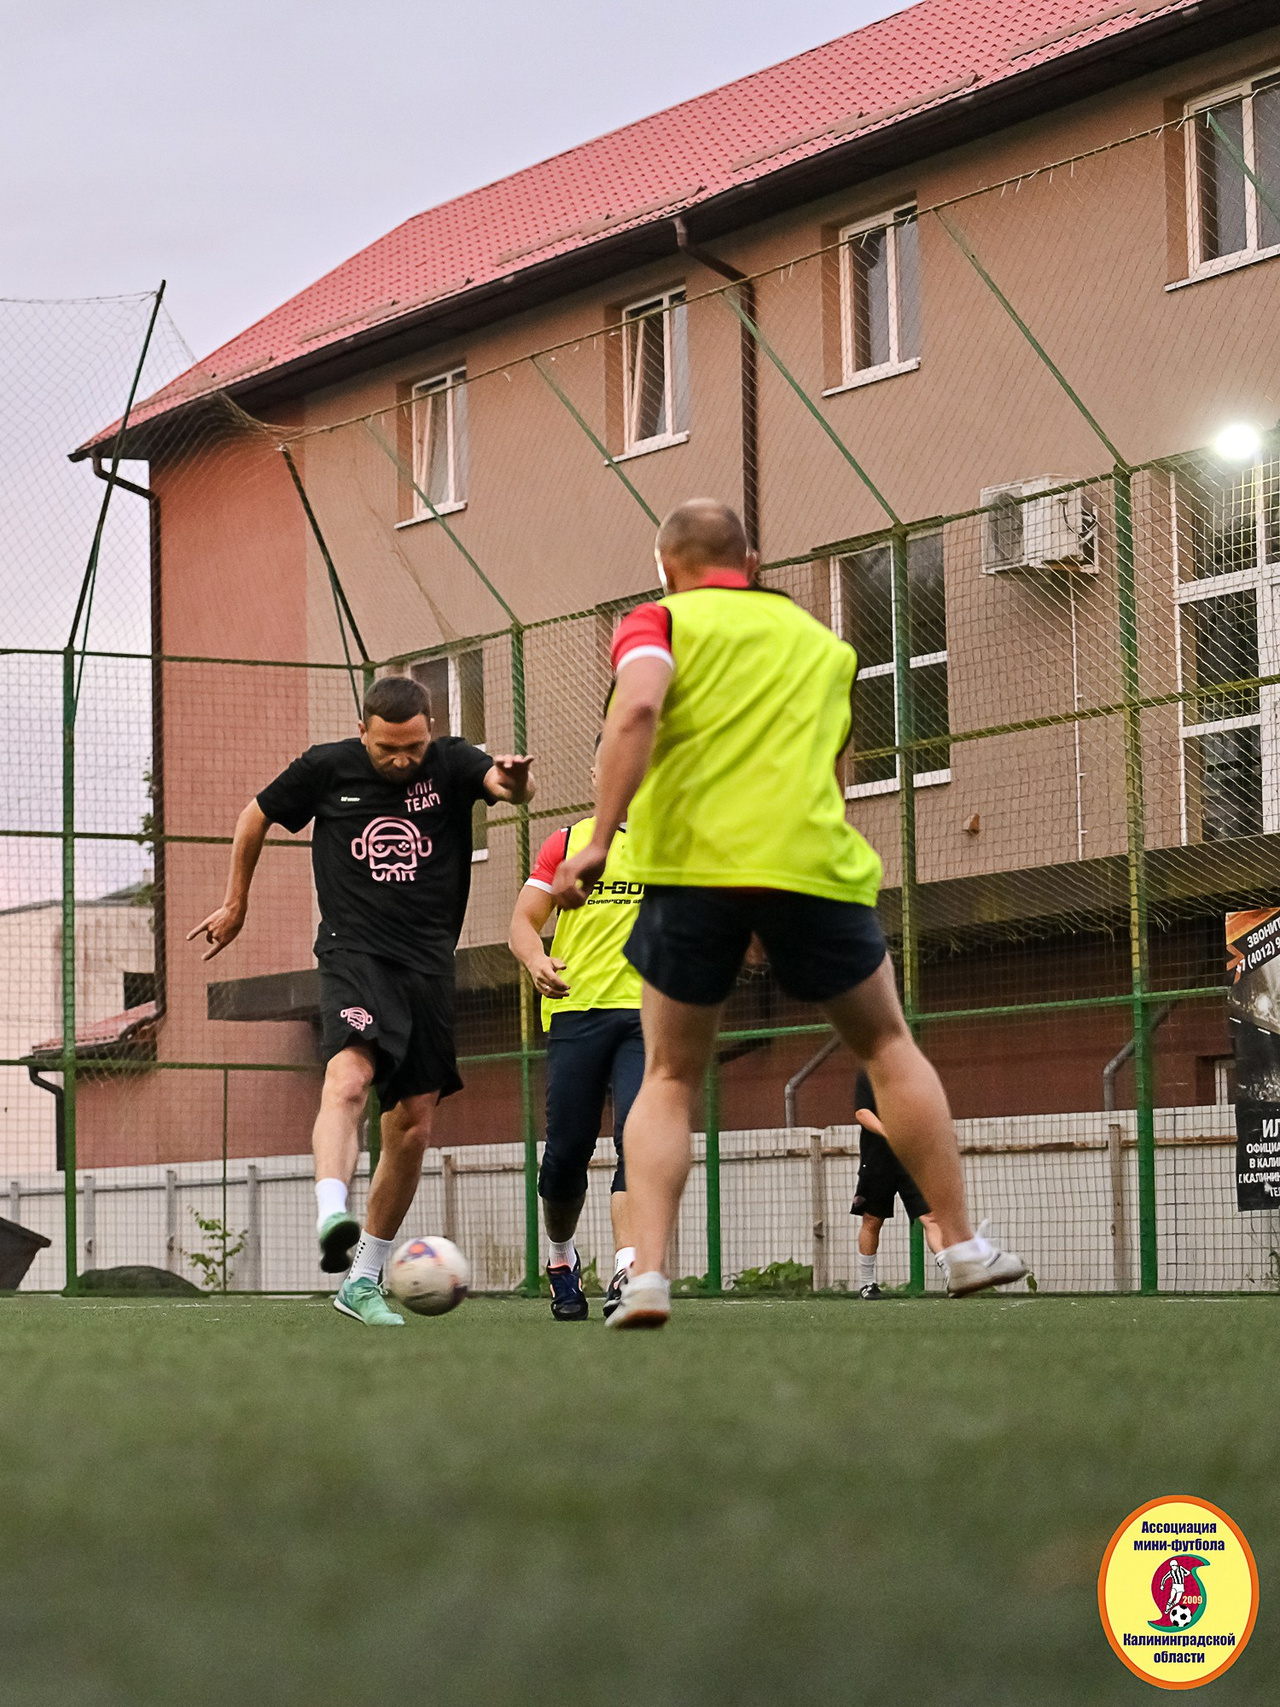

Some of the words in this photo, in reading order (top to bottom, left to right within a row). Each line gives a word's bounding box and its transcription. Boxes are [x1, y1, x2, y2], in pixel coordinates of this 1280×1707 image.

[407, 778, 433, 797] UNIT
[404, 793, 440, 812] TEAM
[371, 868, 417, 881] UNIT
[1247, 941, 1276, 970] (4012)
[1249, 1158, 1256, 1169] В
